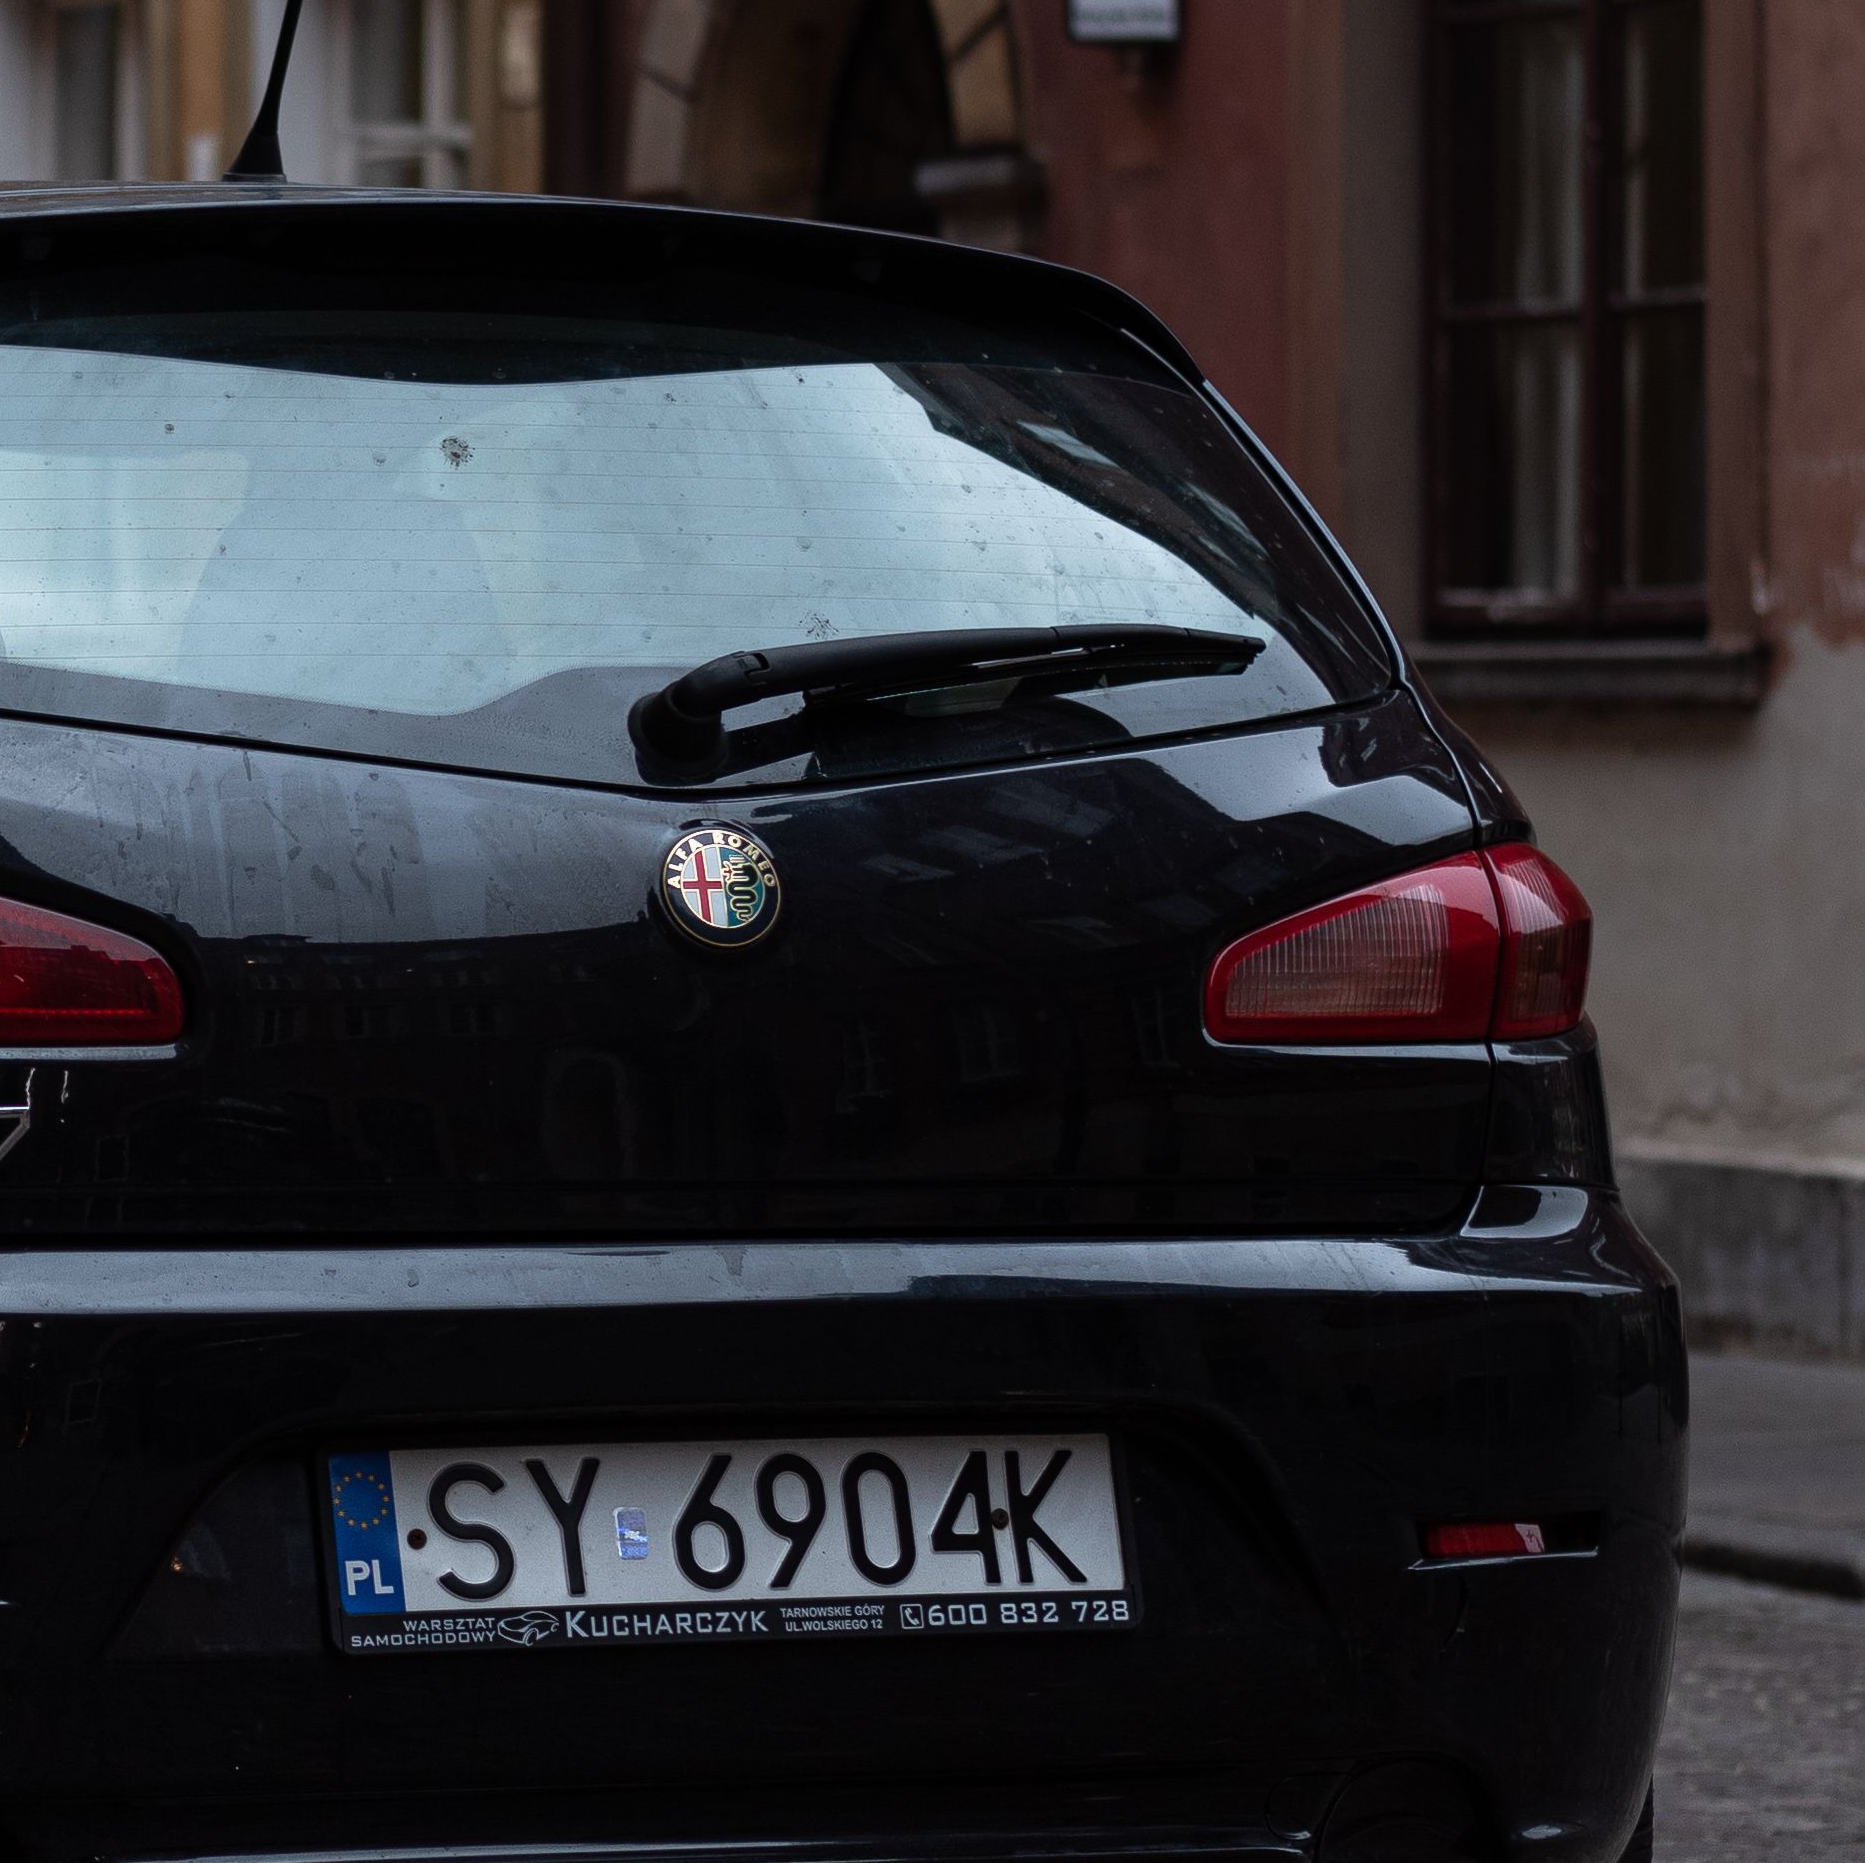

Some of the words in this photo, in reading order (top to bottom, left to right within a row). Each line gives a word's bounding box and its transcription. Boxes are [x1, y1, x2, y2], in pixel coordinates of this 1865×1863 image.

[667, 838, 703, 889] ALFA
[712, 831, 776, 887] ROMEO
[428, 1457, 601, 1602] SY
[672, 1449, 1089, 1591] 6904K
[344, 1559, 395, 1596] PL
[780, 1604, 853, 1618] TARNOWSKIE
[854, 1603, 885, 1616] GÓRY
[927, 1604, 988, 1626] 600
[999, 1602, 1060, 1624] 832
[1071, 1600, 1130, 1622] 728
[402, 1617, 497, 1631] WARSZTAT
[565, 1610, 770, 1639] KUCHARCZYK
[785, 1619, 869, 1632] UL.WOLSKIEGO
[870, 1618, 884, 1629] 12
[350, 1630, 497, 1648] SAMOCHODOWY
